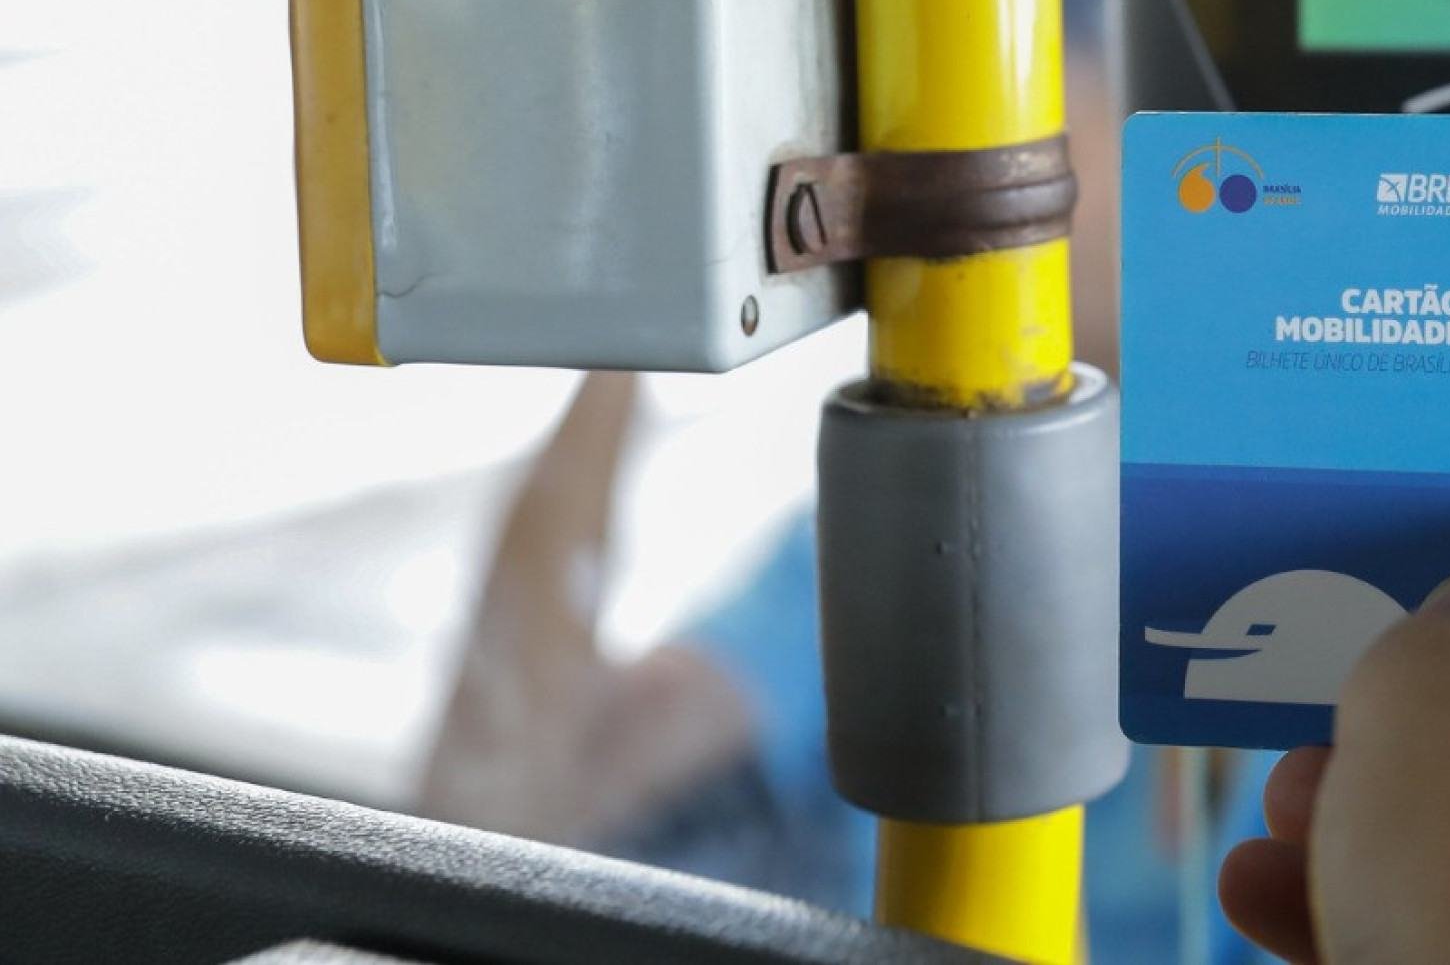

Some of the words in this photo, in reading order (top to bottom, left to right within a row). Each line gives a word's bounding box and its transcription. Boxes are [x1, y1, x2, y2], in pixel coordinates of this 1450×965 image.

[1246, 351, 1308, 369] BILHETE
[1313, 348, 1364, 372] ÚNICO
[1367, 352, 1389, 372] DE
